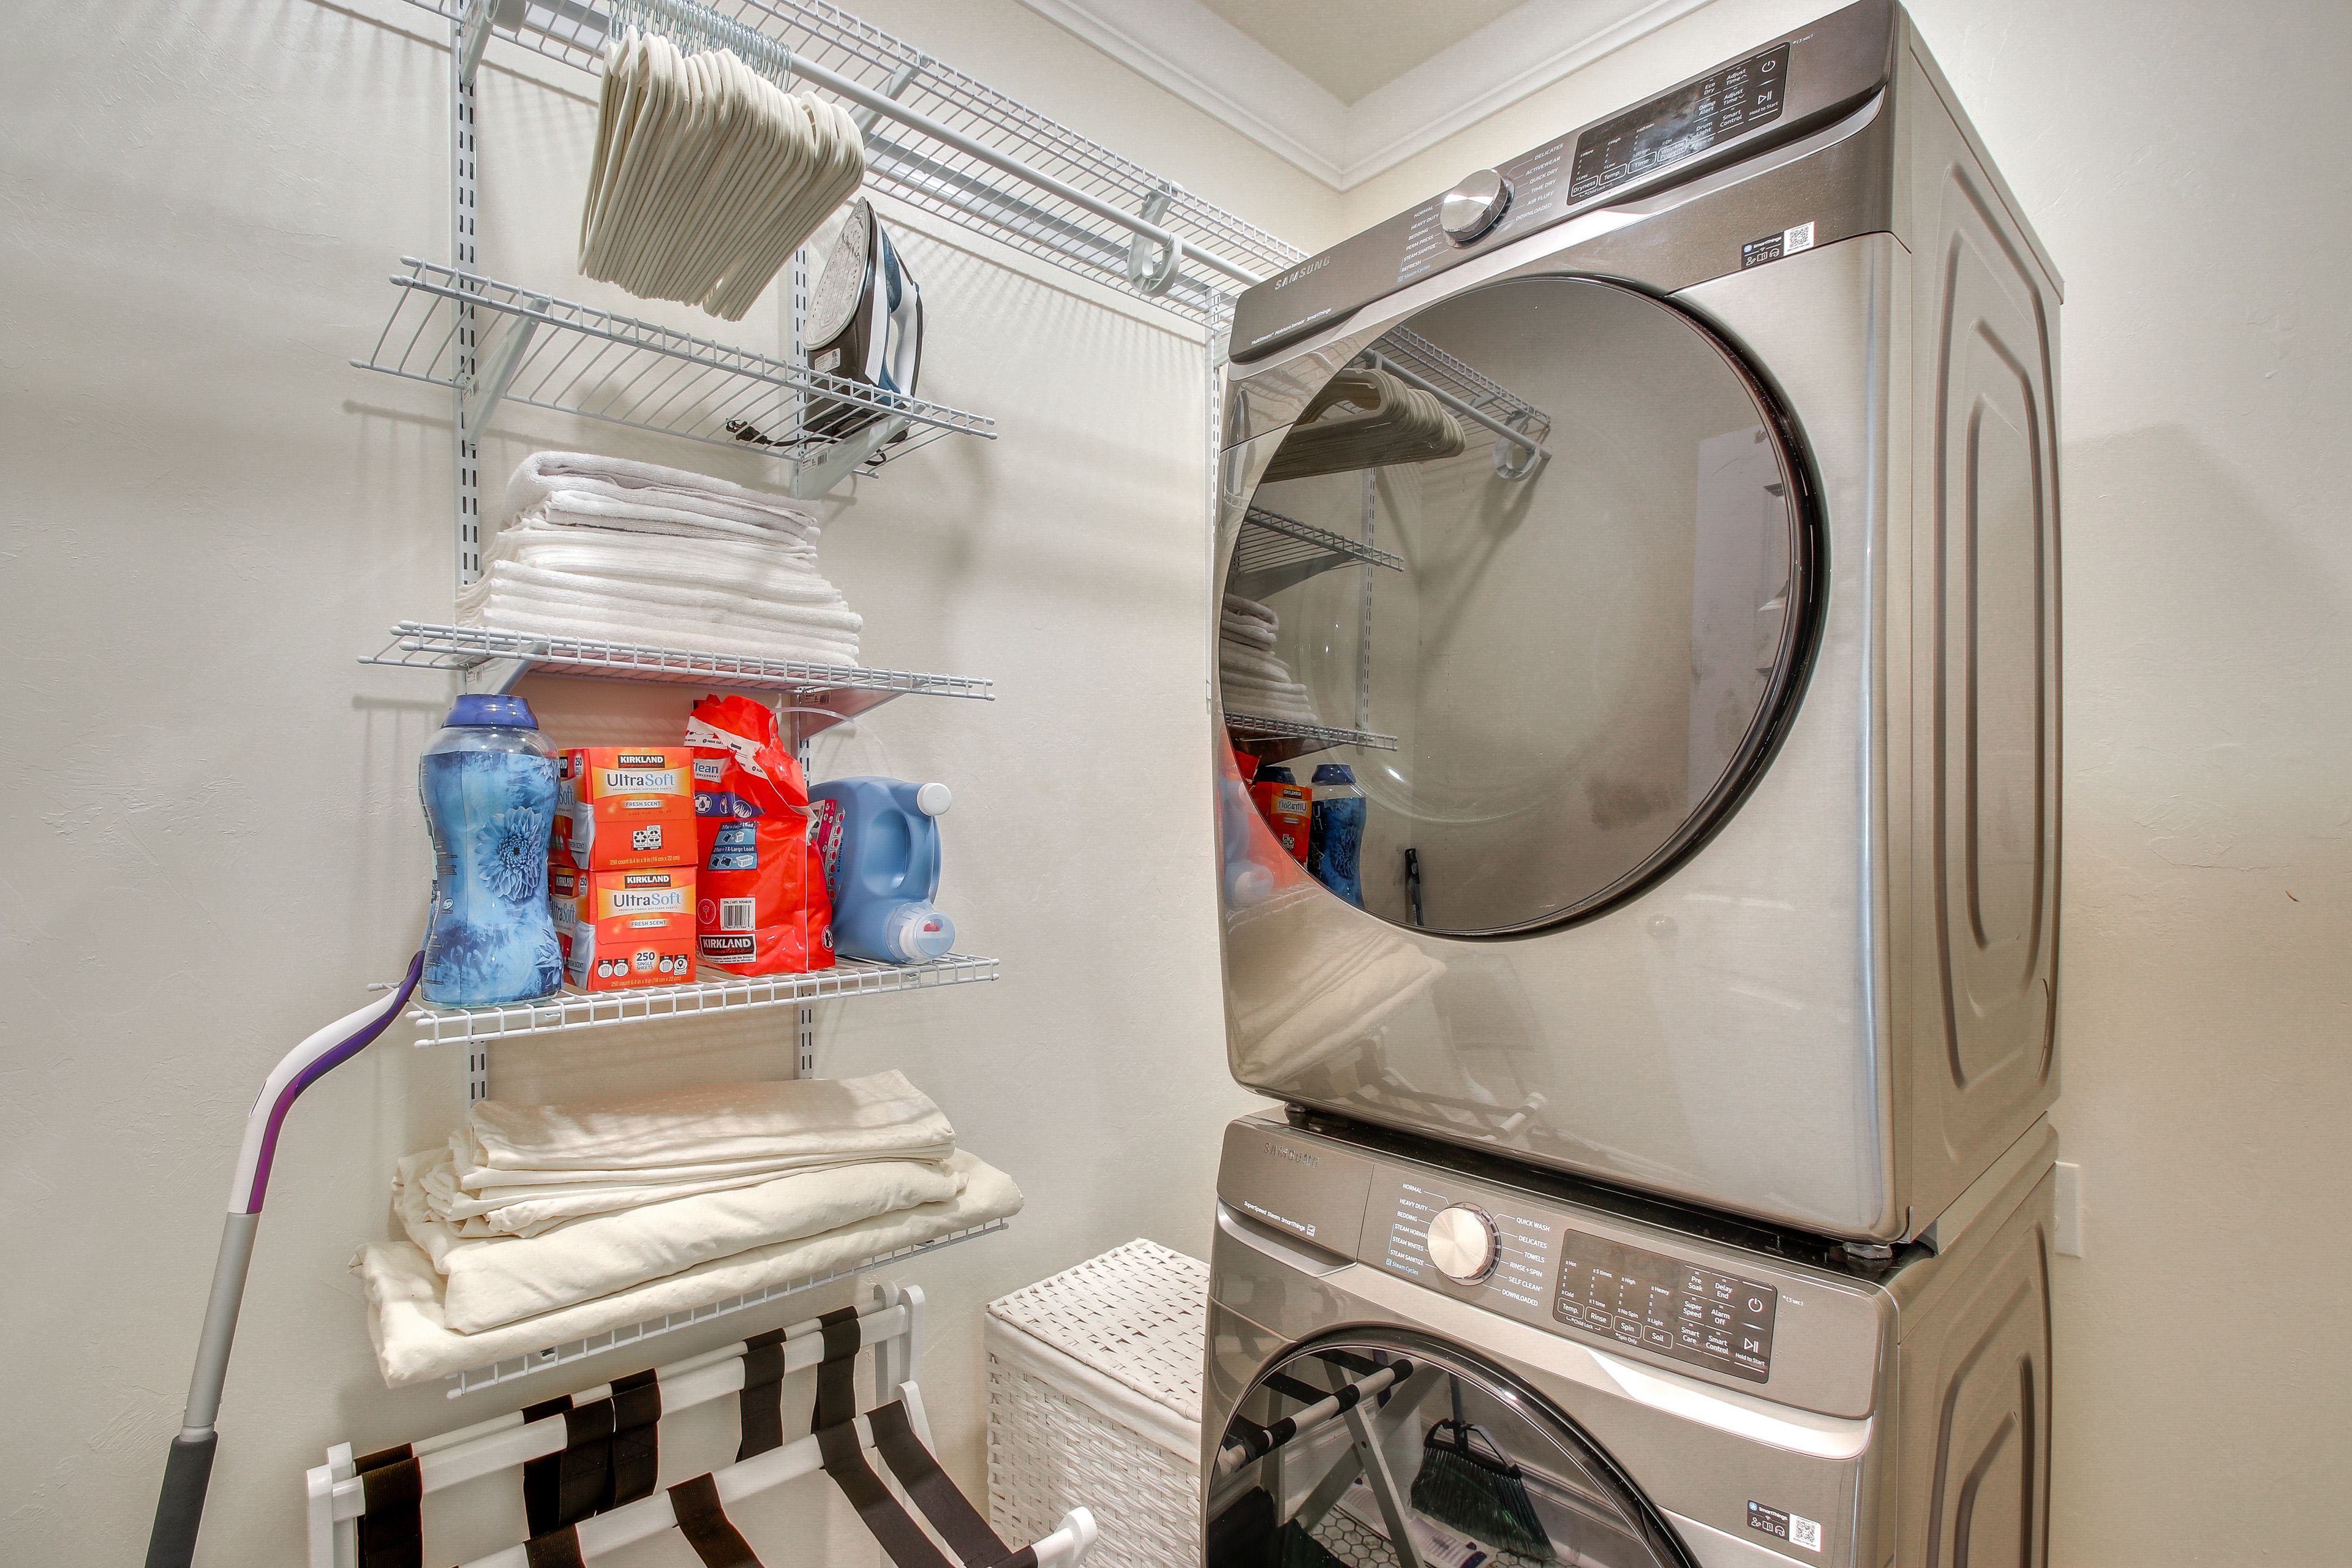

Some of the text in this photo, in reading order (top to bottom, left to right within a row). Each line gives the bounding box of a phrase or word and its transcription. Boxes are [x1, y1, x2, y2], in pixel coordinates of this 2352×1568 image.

[1726, 68, 1746, 80] Adjust
[1725, 77, 1741, 86] Time
[1723, 89, 1743, 101] Adjust
[1698, 100, 1716, 111] Damp
[1722, 97, 1738, 106] Time
[1698, 105, 1714, 116] Alert
[1749, 107, 1760, 116] Hold
[1766, 101, 1779, 110] Start
[1719, 115, 1743, 127] Control
[1722, 110, 1741, 121] Smart
[1696, 121, 1713, 132] Drum
[1696, 127, 1711, 137] Light
[1610, 137, 1621, 145] High
[1534, 143, 1564, 160] DELICATES
[1525, 156, 1561, 176] ACTIVEWEAR
[1634, 159, 1649, 168] Time
[1529, 167, 1559, 184] QUICK DRY
[1604, 170, 1621, 181] Temp.
[1531, 178, 1556, 194] TIME DRY
[1573, 179, 1596, 194] Dryness
[1537, 190, 1555, 202] FLUFF
[1414, 206, 1434, 218] NORMAL
[1515, 203, 1552, 221] DOWNLOADED
[1411, 213, 1439, 230] HEAVY DUTY
[1408, 227, 1430, 241] BEDDING
[1406, 235, 1434, 251] PERM PRESS
[1753, 236, 1782, 249] SmartThings
[1403, 252, 1418, 262] STEAM
[1401, 259, 1422, 273] REFRESH
[1403, 264, 1431, 280] Steam Cycles
[1274, 255, 1331, 290] SAMSUNG
[1275, 307, 1332, 336] Moisture Sensor SmartThings
[607, 773, 675, 786] UltraSoft
[556, 876, 574, 888] KIRKLAND
[627, 875, 669, 884] KIRKLAND
[614, 892, 681, 907] UltraSoft
[703, 938, 752, 948] KIRKLAND
[636, 952, 655, 962] 250
[1264, 1142, 1319, 1169] SAMSUNG
[1403, 1183, 1422, 1194] NORMAL
[1400, 1198, 1428, 1212] HEAVY DUTY
[1244, 1200, 1305, 1232] SuperSpeed Steam SmartThings
[1397, 1210, 1417, 1222] BEDDING
[1516, 1217, 1550, 1232] QUICK WASH
[1395, 1223, 1428, 1239] STEAM NORMAL
[1392, 1236, 1424, 1251] STEAM WHITES
[1518, 1235, 1547, 1249] DELICATES
[1390, 1249, 1424, 1266] STEAM SANITIZE
[1524, 1251, 1545, 1263] TOWELS
[1392, 1261, 1419, 1275] Steam Cycles
[1508, 1276, 1522, 1285] SELF
[1654, 1286, 1670, 1295] Heavy
[1688, 1283, 1703, 1292] Soak
[1715, 1282, 1733, 1294] Delay
[1502, 1289, 1539, 1306] DOWNLOADED
[1717, 1291, 1729, 1300] End
[1684, 1301, 1702, 1311] Super
[1792, 1298, 1804, 1306] sec)
[1562, 1303, 1579, 1314] Temp.
[1683, 1308, 1702, 1318] Speed
[1711, 1308, 1730, 1320] Alarm
[1590, 1313, 1607, 1324] Rinse
[1650, 1317, 1664, 1327] Light
[1714, 1317, 1726, 1325] Off
[1621, 1322, 1634, 1333] Spin
[1681, 1327, 1700, 1338] Smart
[1651, 1332, 1664, 1342] Soil
[1683, 1335, 1697, 1344] Care
[1708, 1335, 1728, 1346] Smart
[1705, 1343, 1729, 1355] Control
[1735, 1352, 1747, 1361] Hold
[1752, 1357, 1765, 1366] Start
[1758, 1507, 1788, 1521] SmartThings
